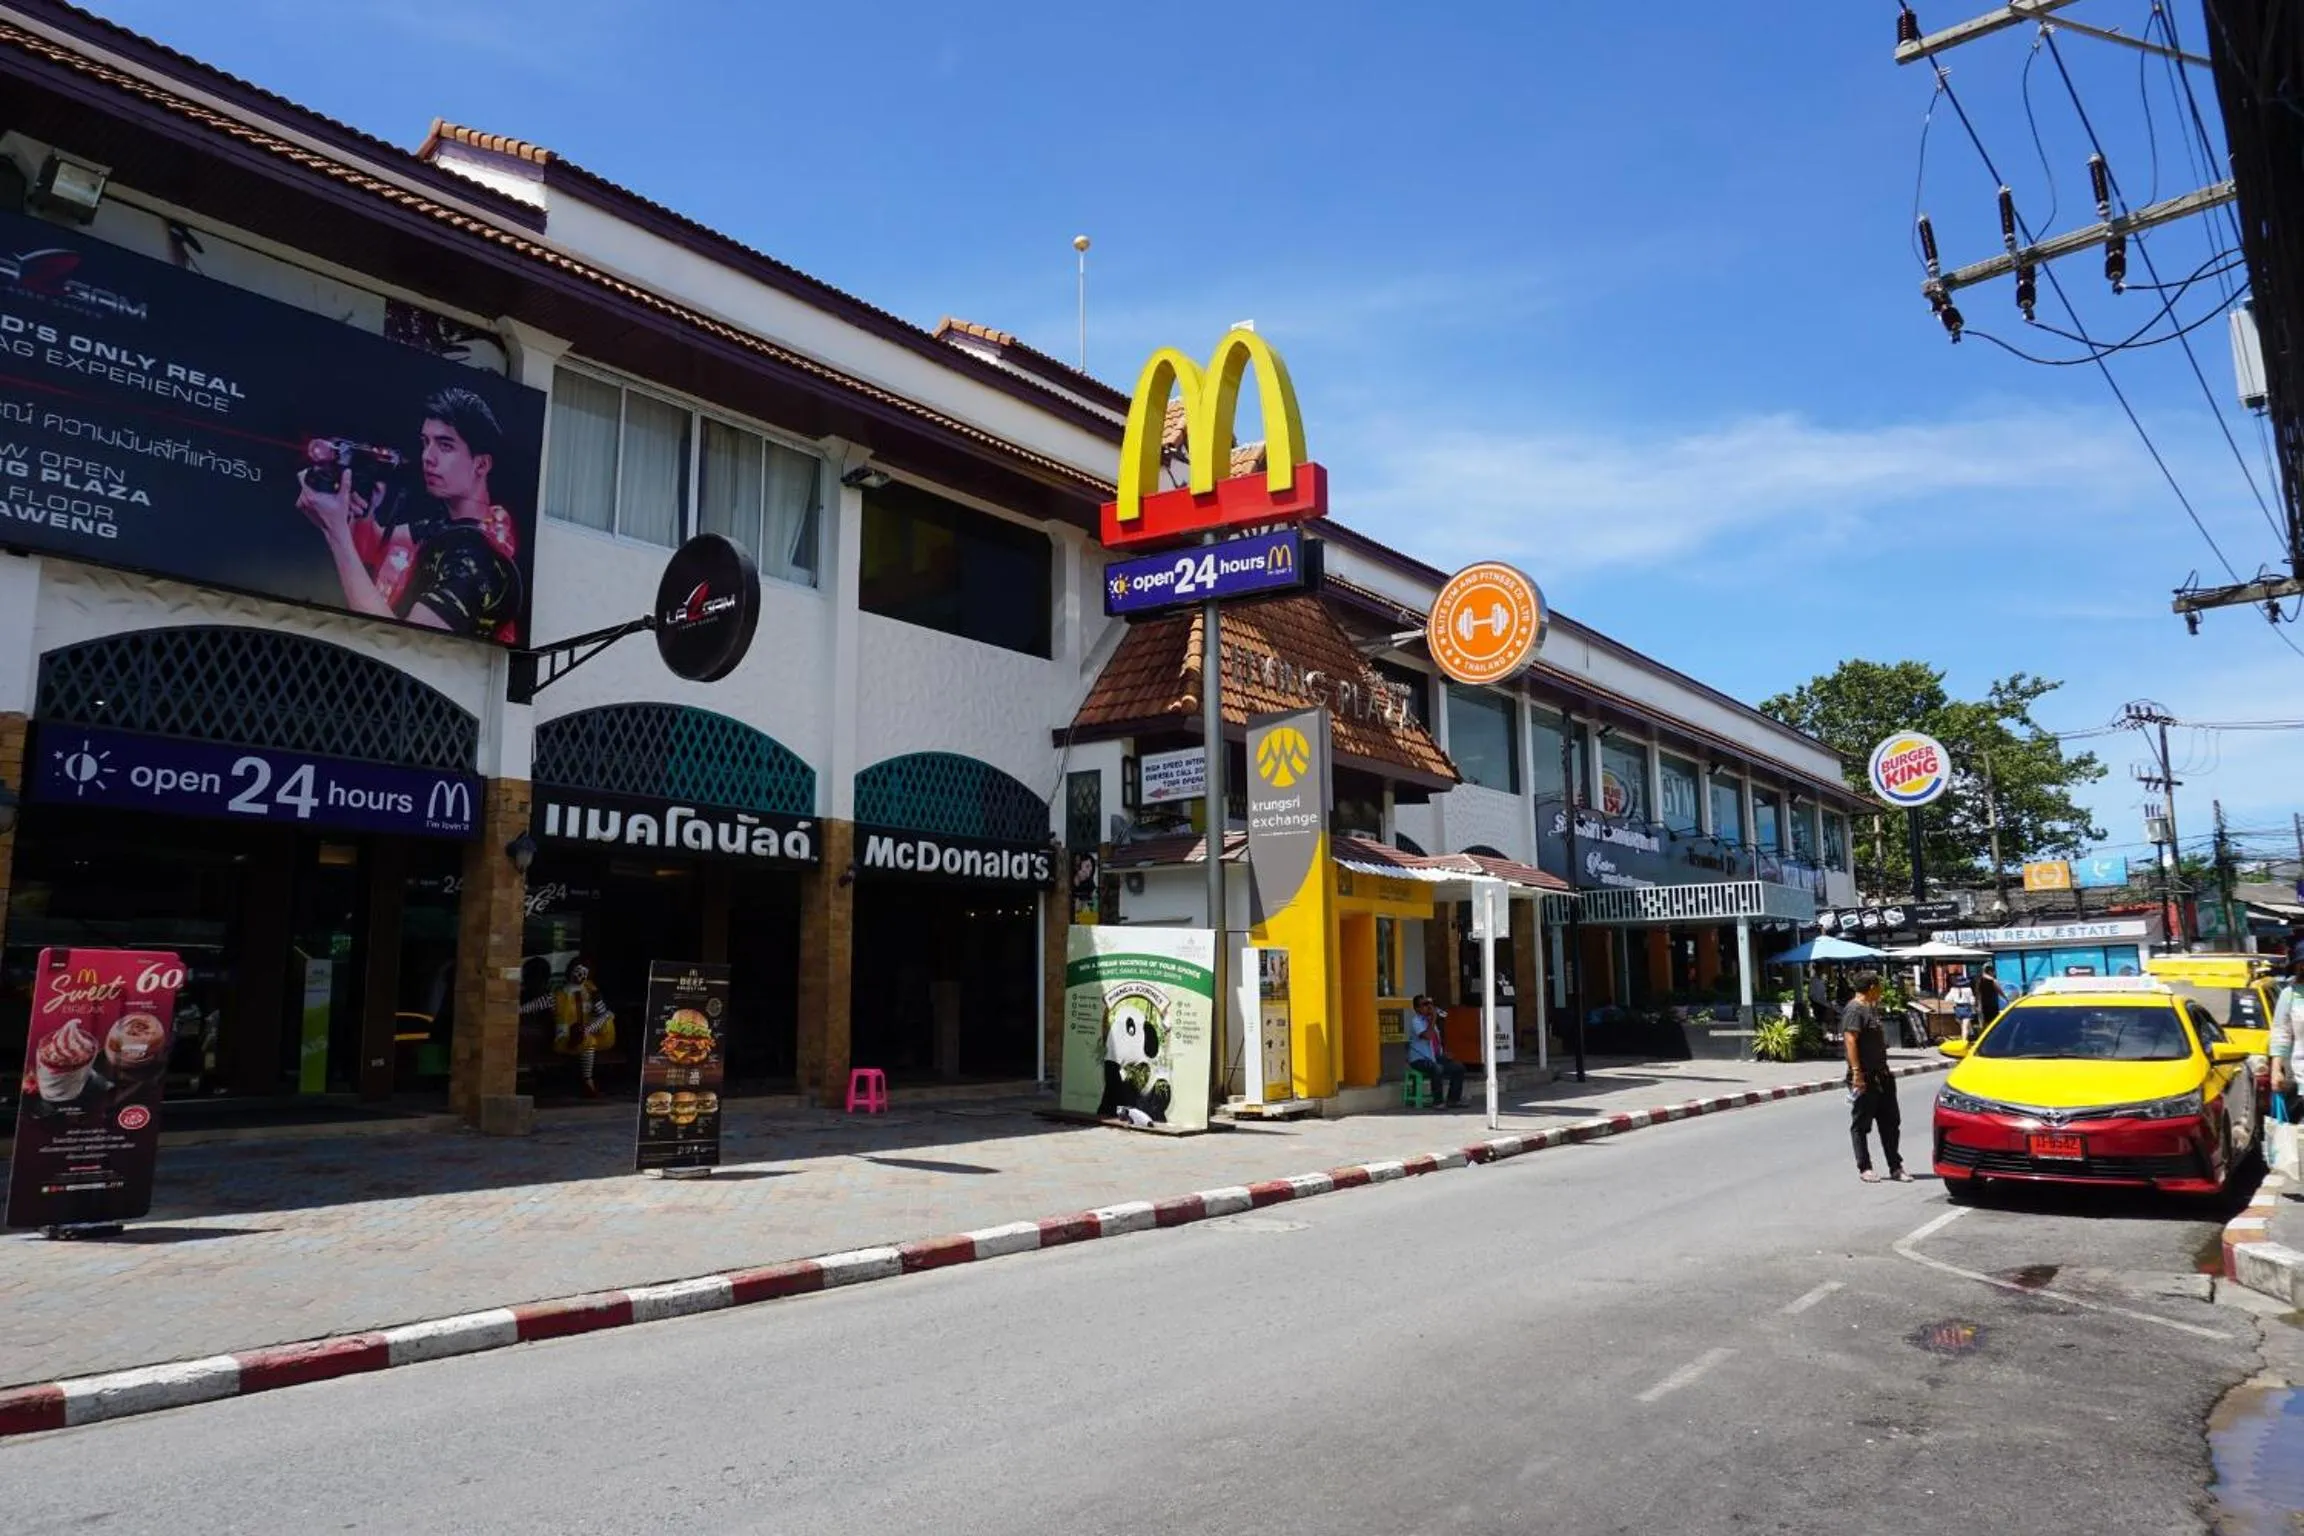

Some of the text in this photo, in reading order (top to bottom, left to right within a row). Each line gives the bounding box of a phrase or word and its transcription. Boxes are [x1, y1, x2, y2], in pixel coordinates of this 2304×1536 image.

[0, 313, 246, 399] D'S ONLY REAL
[46, 348, 231, 413] EXPERIENCE
[39, 450, 126, 484] OPEN
[8, 485, 114, 522] FLOOR
[40, 467, 152, 507] PLAZA
[1133, 570, 1175, 593] open
[1174, 553, 1218, 594] 24
[1220, 556, 1265, 576] hours
[1464, 657, 1506, 672] THAILAND
[1880, 744, 1936, 774] BURGER
[1884, 759, 1940, 792] KING
[130, 755, 414, 820] open 24 hours
[1252, 795, 1301, 815] krungsri
[543, 801, 813, 861] แมคโดนัลด์
[1252, 812, 1318, 828] exchange
[864, 834, 1049, 882] McDonald's
[2004, 928, 2047, 941] REAL
[2054, 924, 2120, 938] ESTATE
[42, 974, 127, 1014] Sweet
